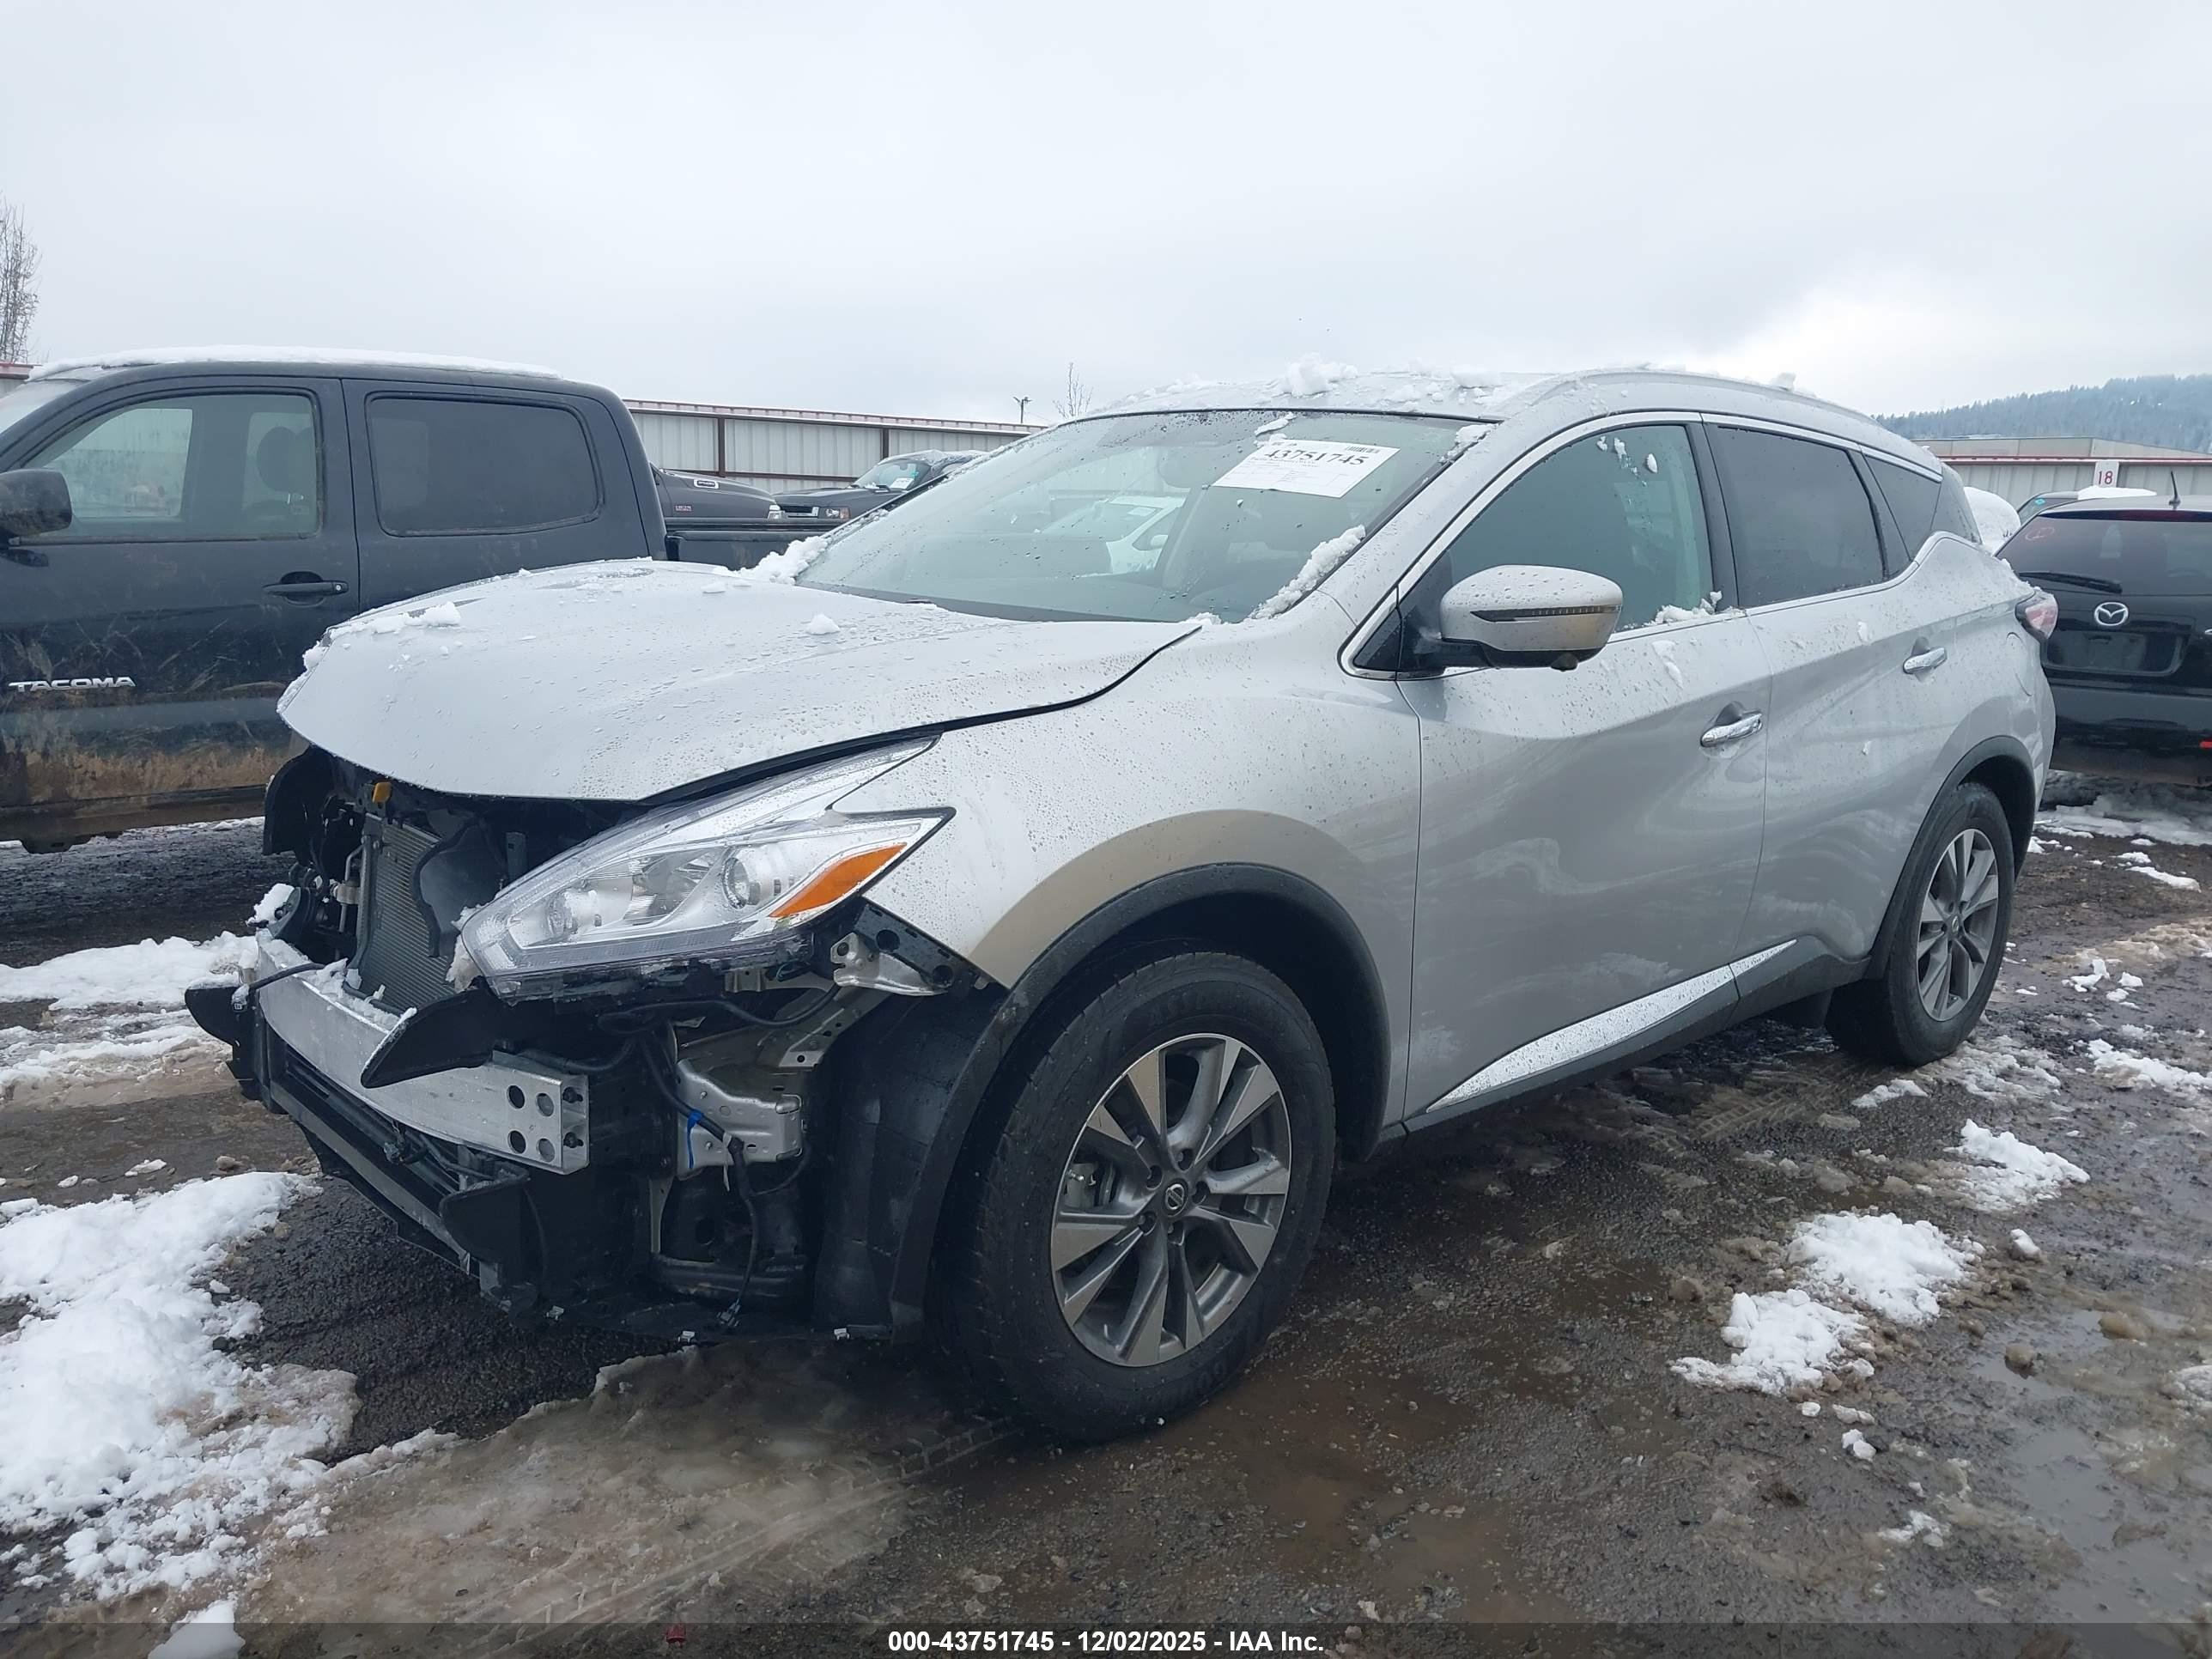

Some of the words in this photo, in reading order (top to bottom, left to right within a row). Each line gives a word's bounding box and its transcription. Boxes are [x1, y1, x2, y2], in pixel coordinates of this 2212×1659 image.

[1264, 449, 1370, 465] 43751745
[2098, 470, 2113, 485] 18
[8, 676, 137, 693] TACOMA
